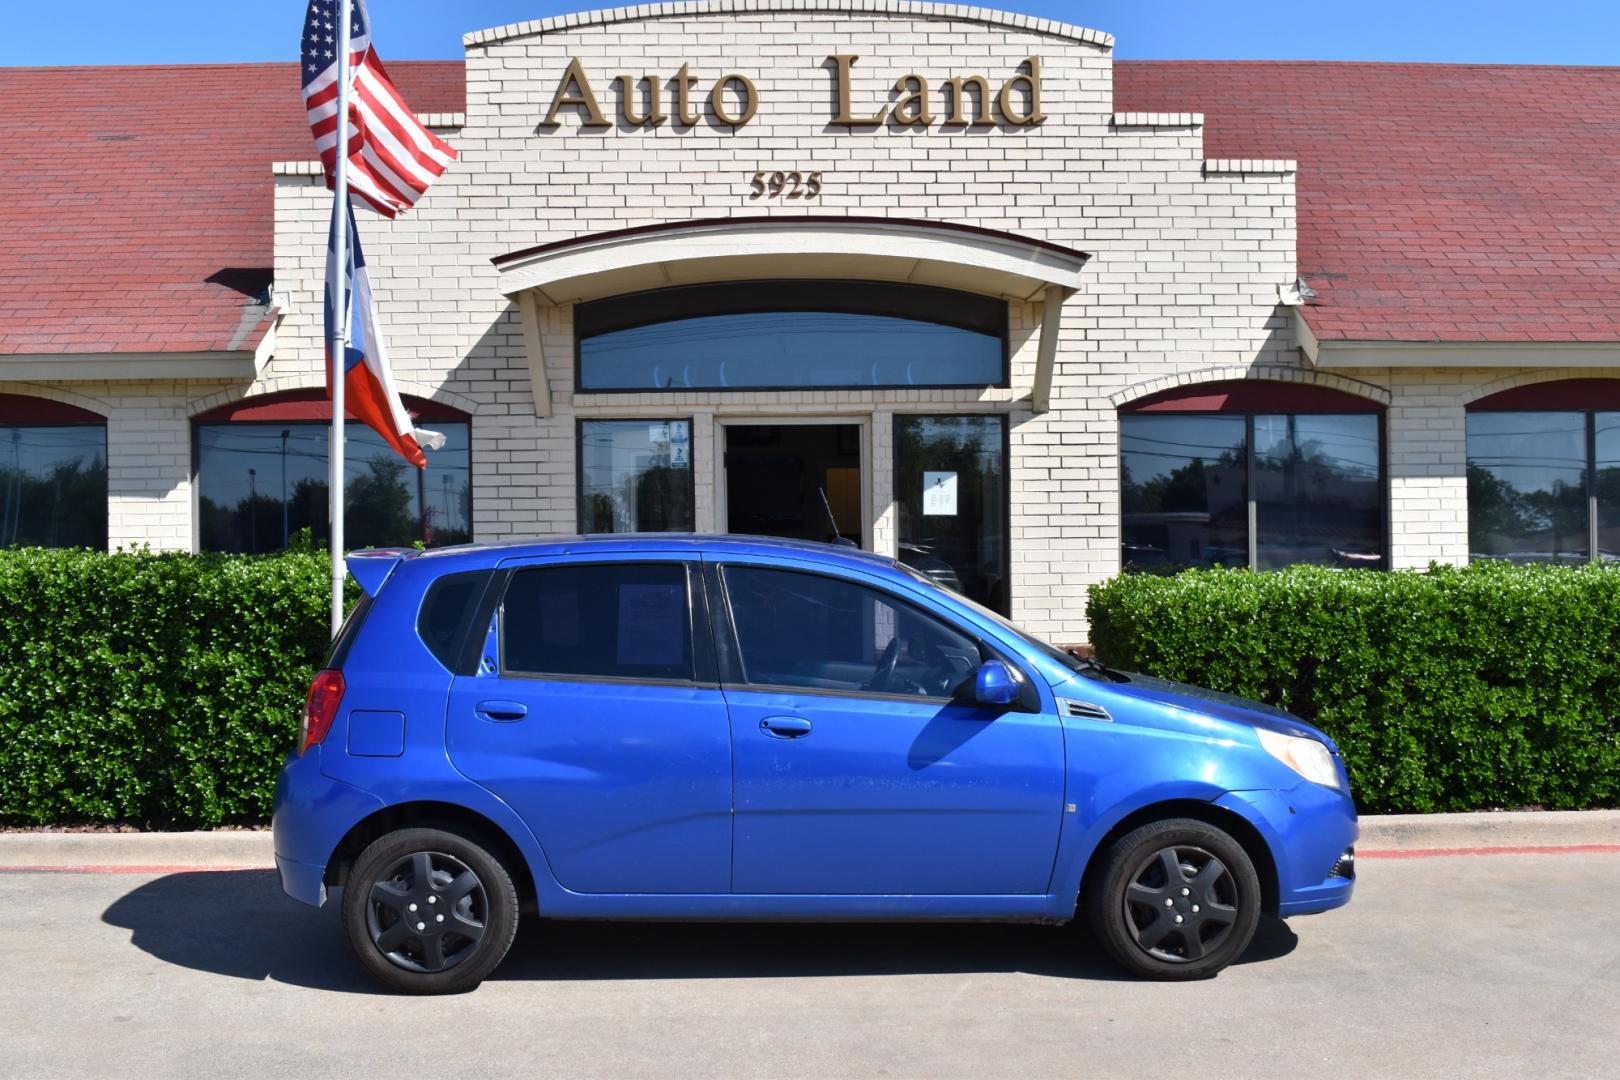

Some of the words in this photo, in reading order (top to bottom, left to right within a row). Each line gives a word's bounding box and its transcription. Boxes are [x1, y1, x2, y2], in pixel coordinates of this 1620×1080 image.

[539, 55, 760, 128] Auto
[825, 53, 1048, 128] Land
[750, 171, 822, 199] 5925
